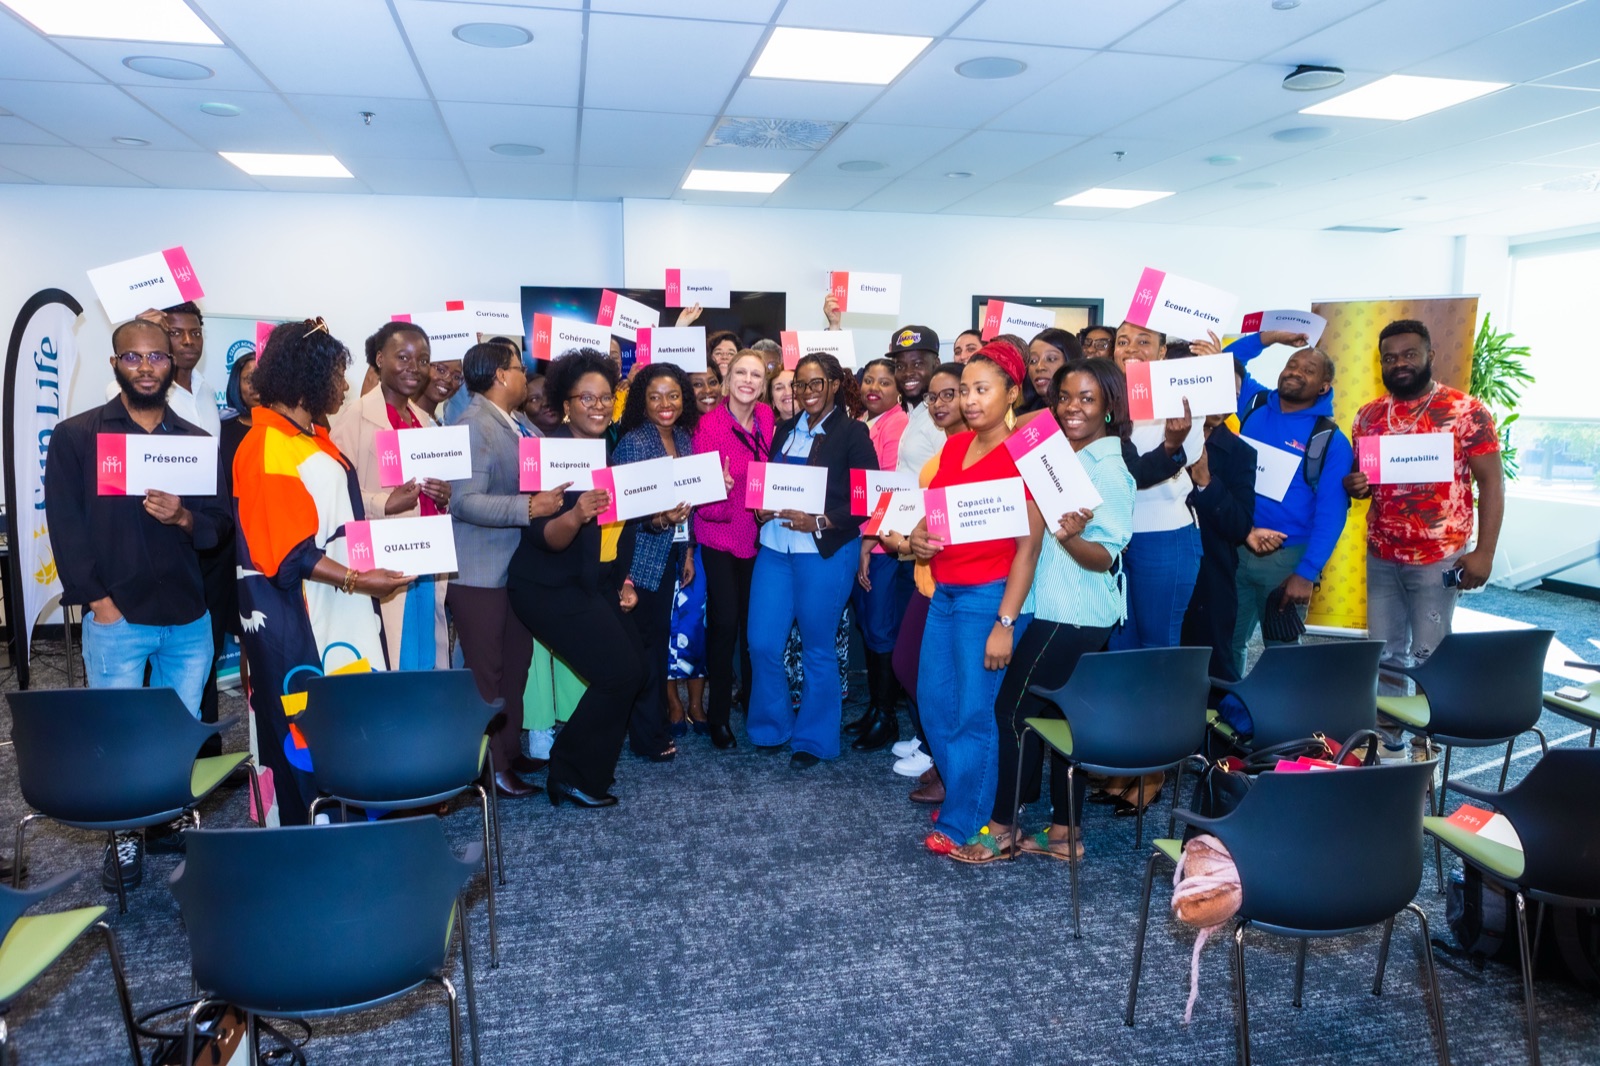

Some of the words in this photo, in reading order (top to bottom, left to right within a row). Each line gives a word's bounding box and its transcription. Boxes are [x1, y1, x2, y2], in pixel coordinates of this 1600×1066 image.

[128, 276, 165, 291] Patience
[860, 284, 887, 294] Éthique
[475, 310, 510, 319] Curiosité
[1164, 299, 1192, 315] Écoute
[1193, 309, 1220, 324] Active
[619, 313, 633, 323] Sens
[633, 318, 640, 326] de
[1006, 316, 1049, 330] Authenticité
[1275, 315, 1311, 325] Courage
[559, 332, 601, 346] Cohérence
[657, 346, 696, 354] Authenticité
[34, 336, 60, 419] Life
[1169, 374, 1213, 387] Passion
[144, 453, 198, 464] Présence
[410, 449, 463, 460] Collaboration
[1389, 454, 1439, 465] Adaptabilité
[549, 461, 591, 470] Réciprocité
[1040, 454, 1064, 494] Inclusion
[673, 476, 702, 487] ALEURS
[623, 483, 658, 496] Constance
[772, 484, 805, 493] Gratitude
[957, 497, 994, 509] Capacité
[958, 506, 1001, 518] connecter
[1002, 504, 1015, 512] les
[959, 519, 987, 528] autres
[384, 540, 431, 553] QUALITÉS
